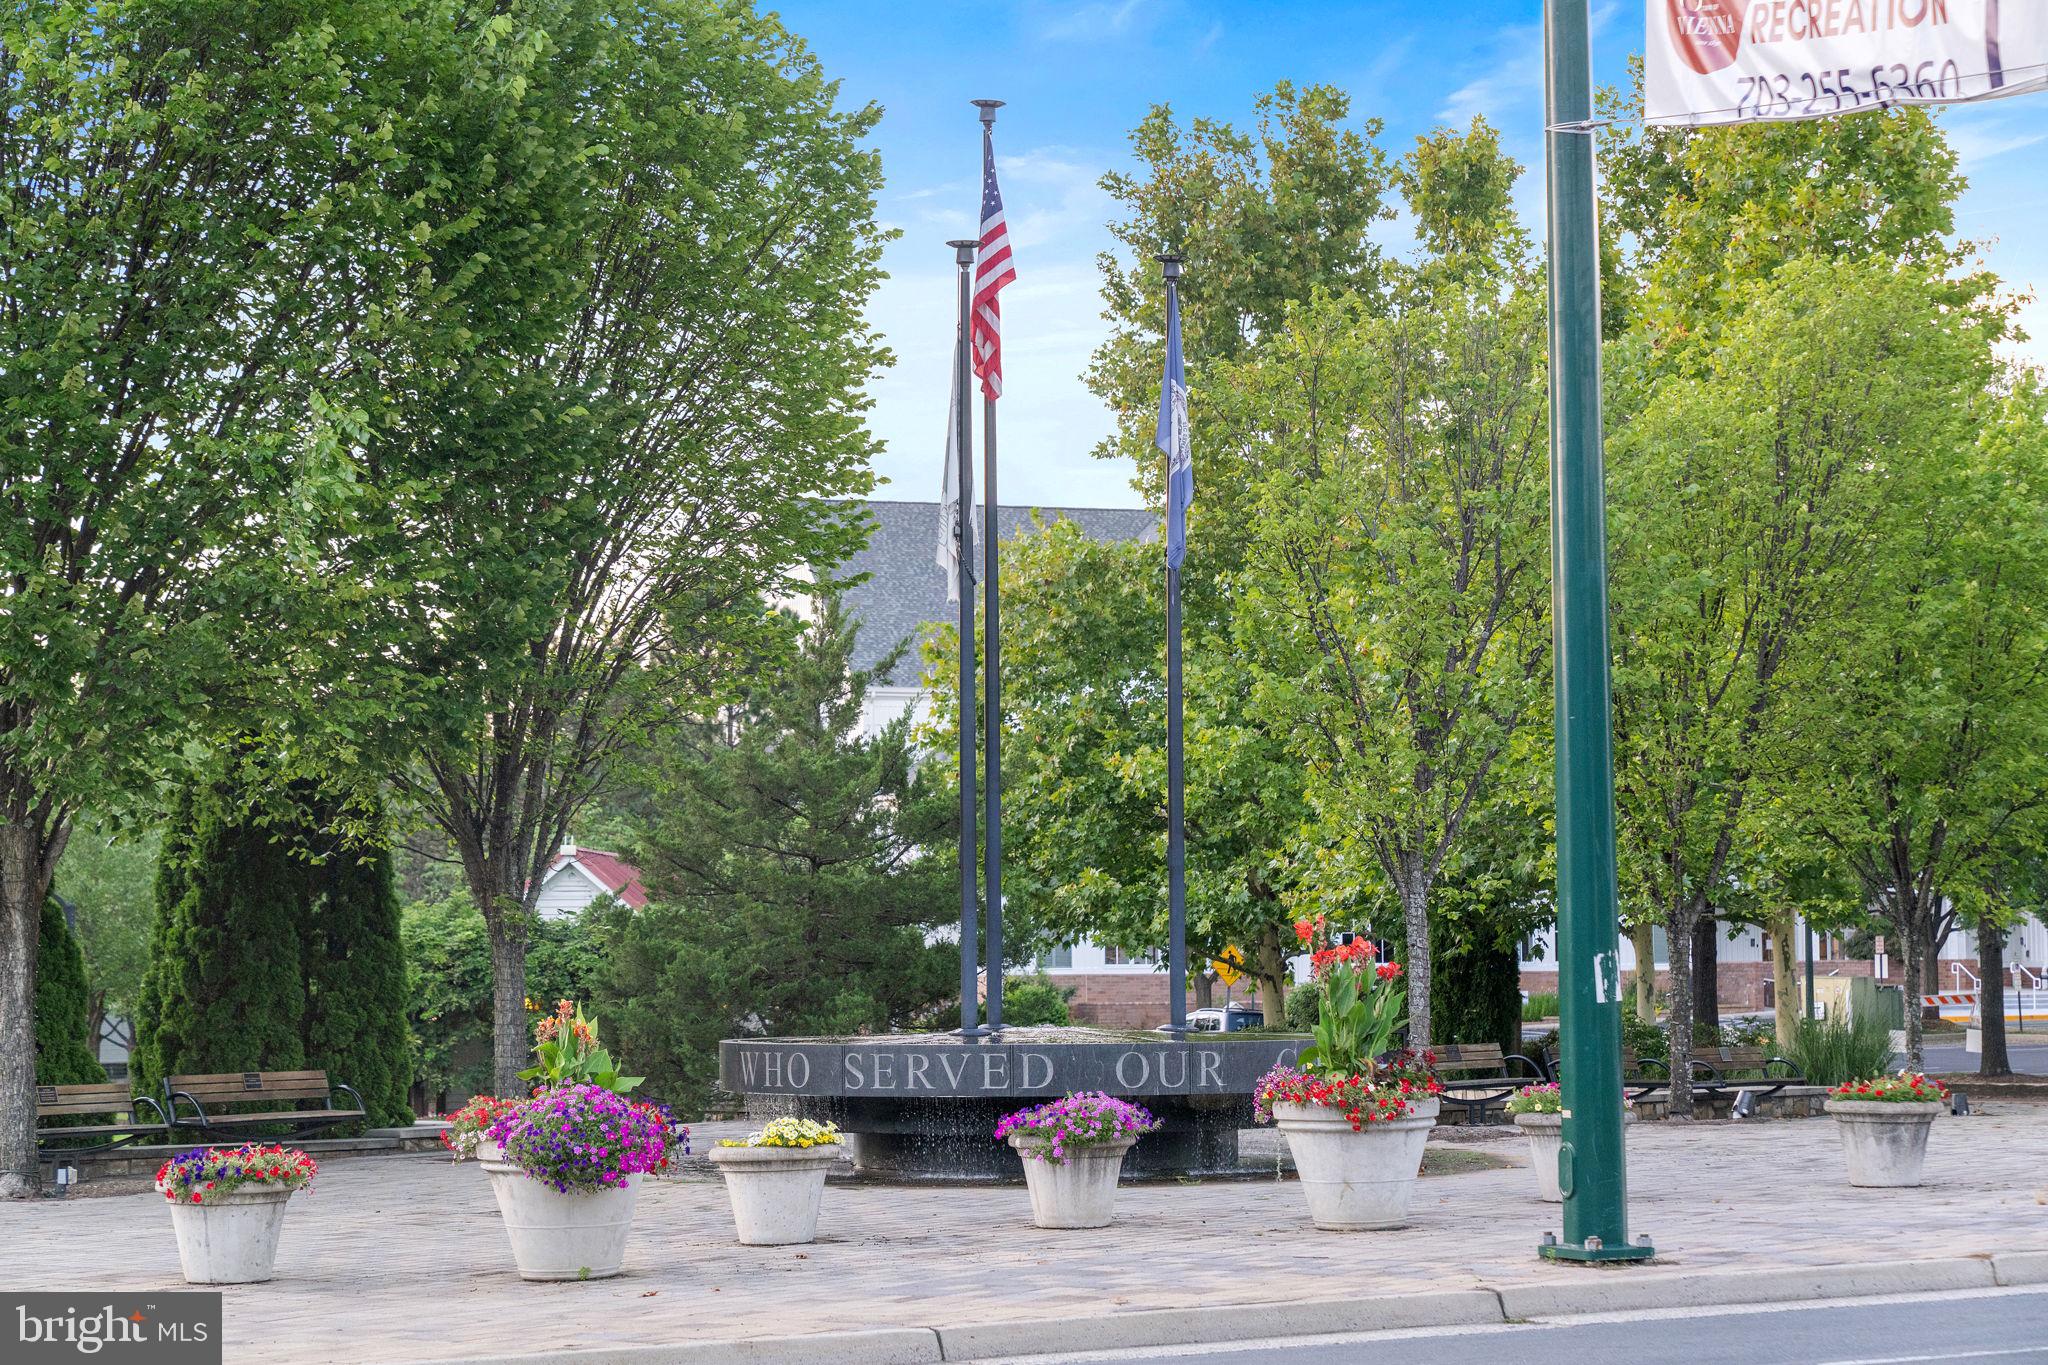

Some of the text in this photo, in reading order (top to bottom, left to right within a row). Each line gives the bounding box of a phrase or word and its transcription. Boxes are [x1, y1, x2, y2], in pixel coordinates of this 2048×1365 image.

[1751, 0, 1948, 44] RECREATION
[1737, 59, 1959, 118] 703-255-6360
[740, 1050, 1228, 1090] WHO SERVED OUR
